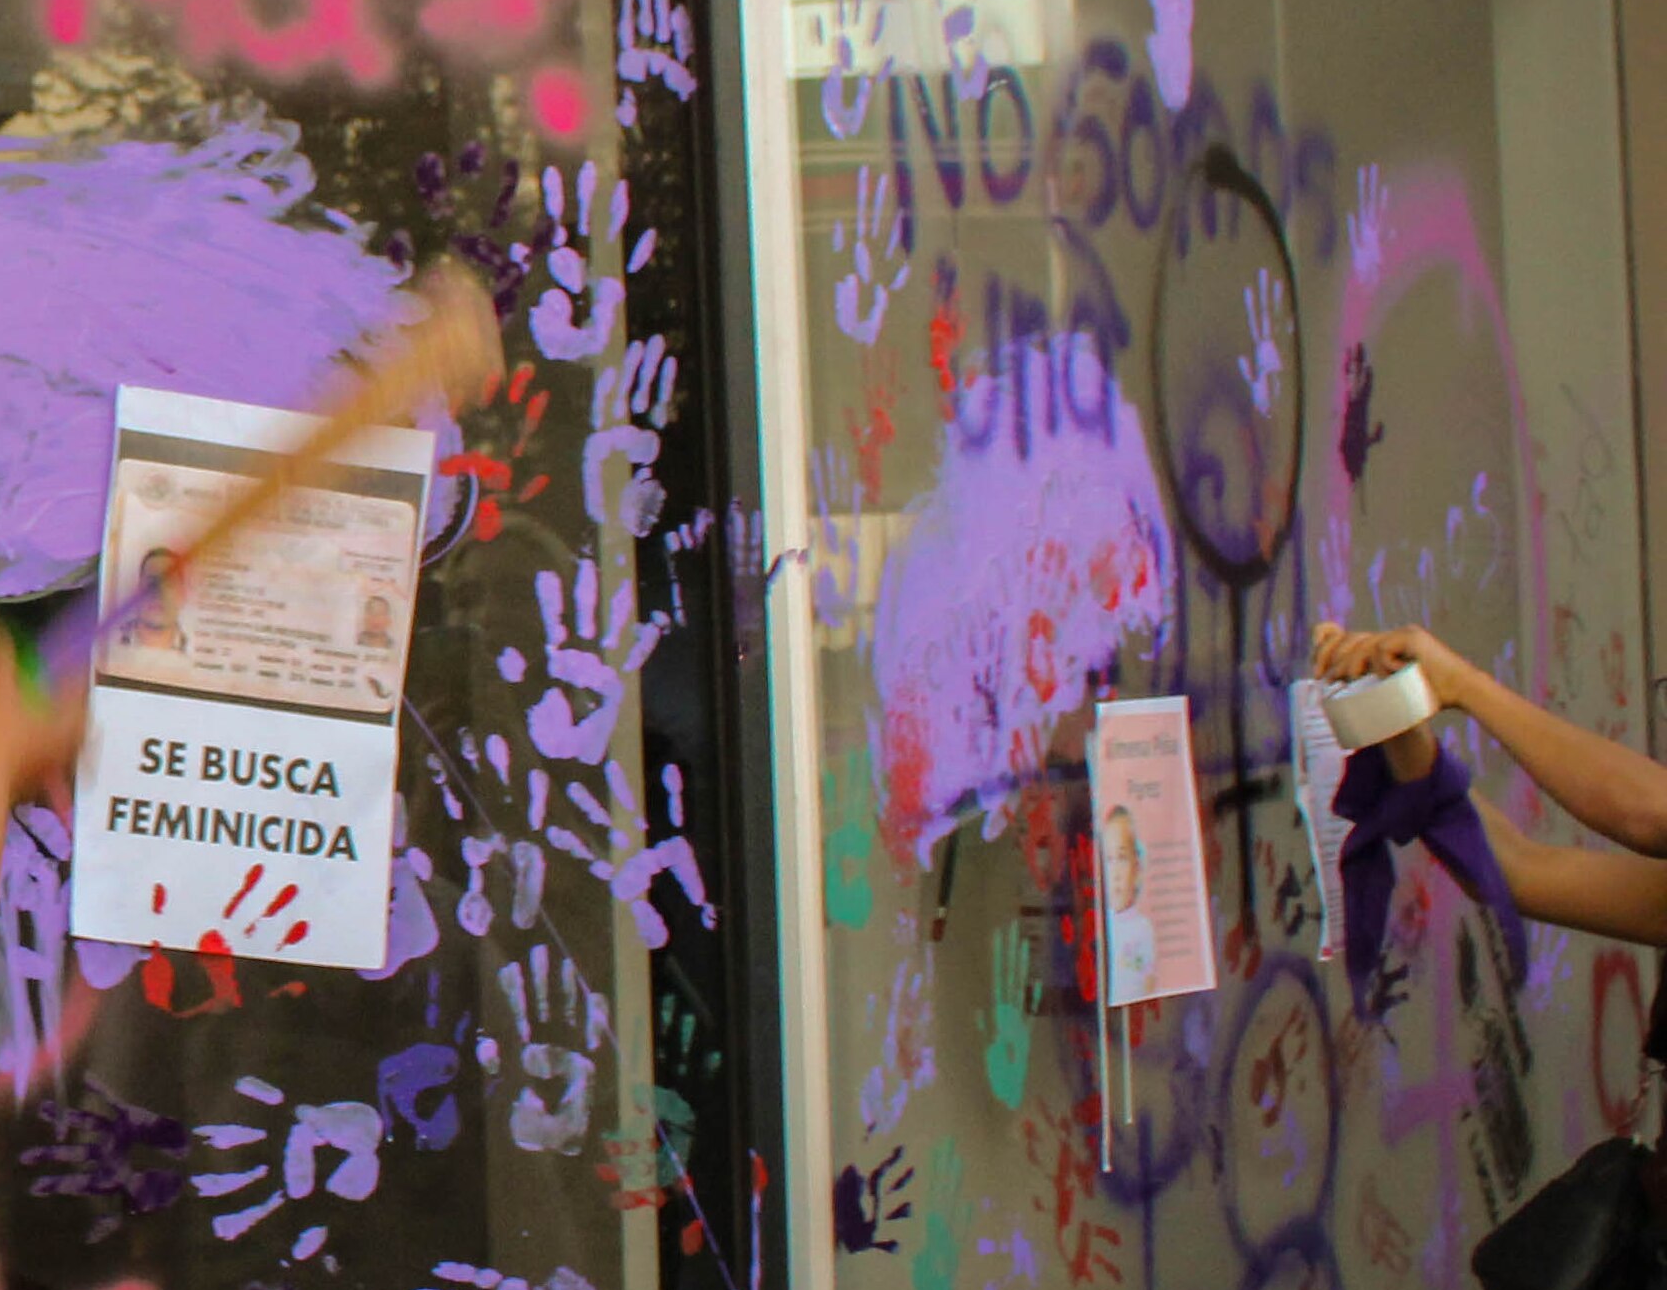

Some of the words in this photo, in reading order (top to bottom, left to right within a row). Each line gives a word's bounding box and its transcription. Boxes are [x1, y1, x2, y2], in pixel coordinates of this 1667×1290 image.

[888, 65, 1032, 258] NO
[138, 736, 186, 779] SE
[199, 744, 341, 799] BUSCA
[105, 794, 359, 862] FEMINICIDA
